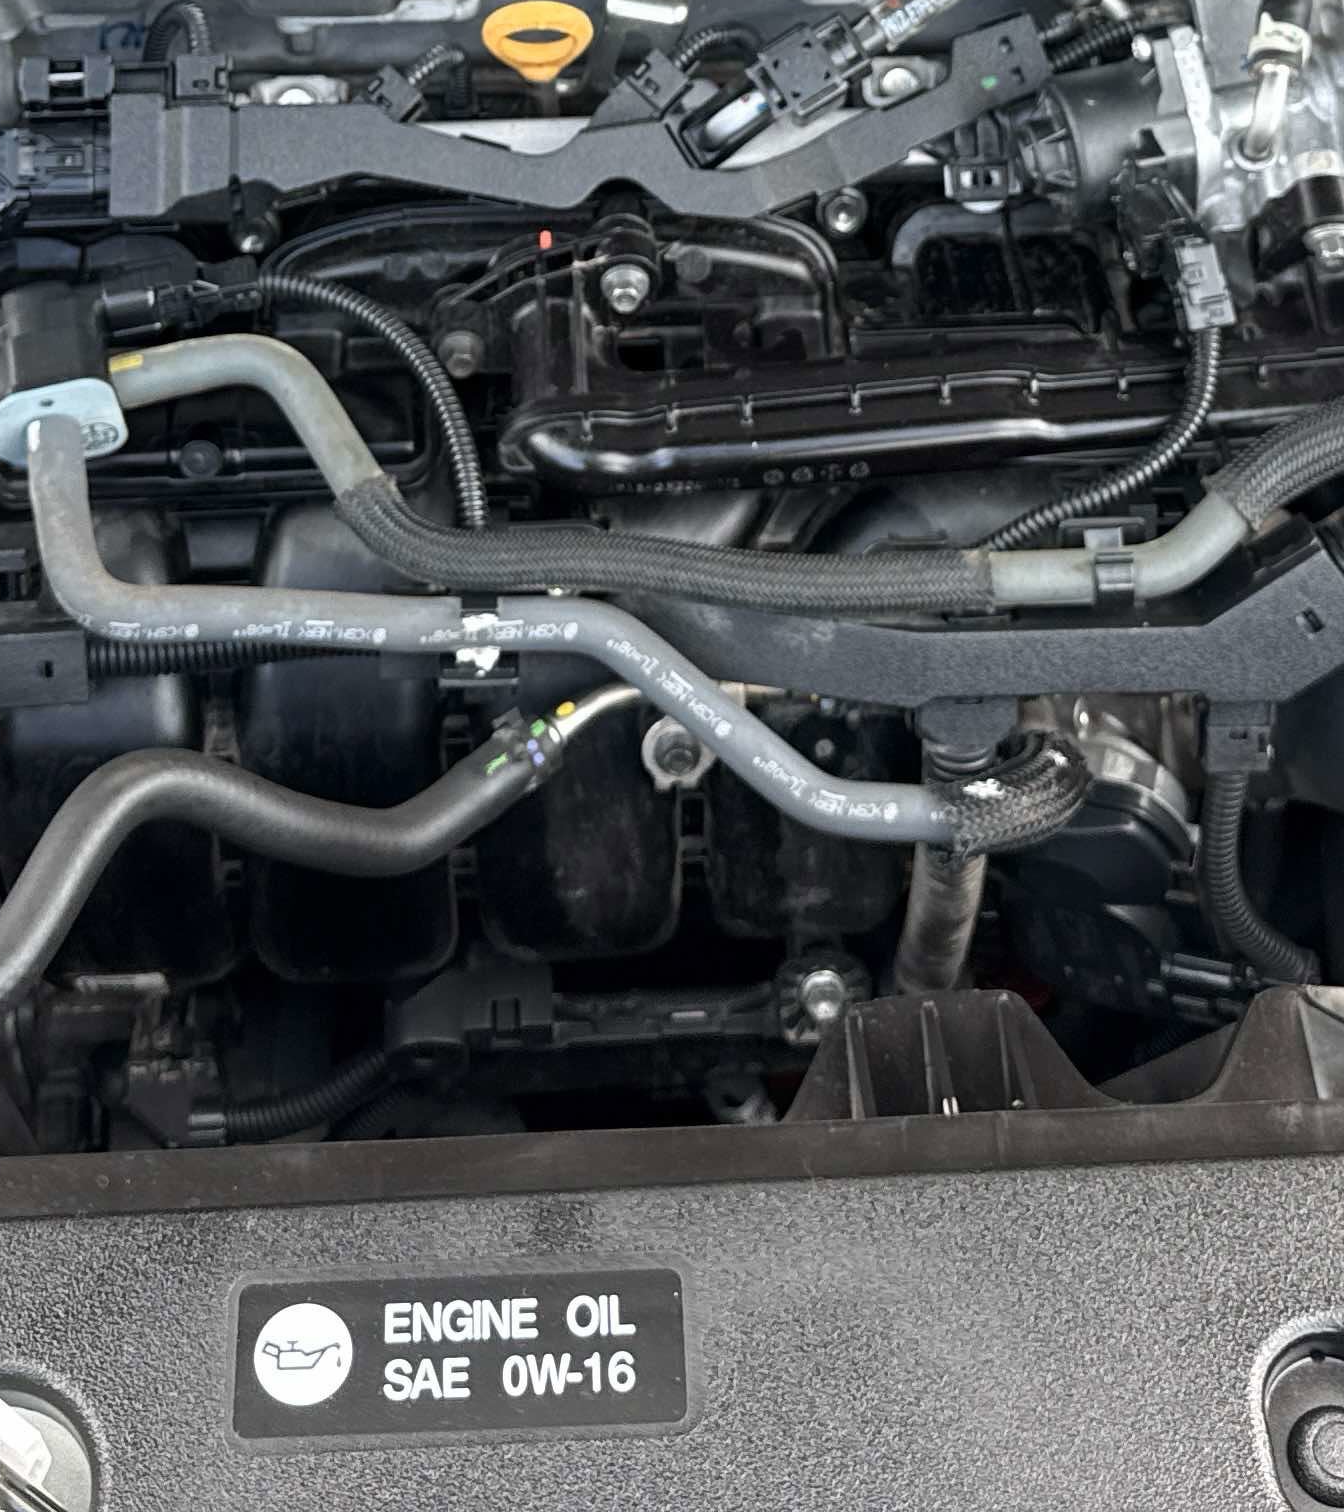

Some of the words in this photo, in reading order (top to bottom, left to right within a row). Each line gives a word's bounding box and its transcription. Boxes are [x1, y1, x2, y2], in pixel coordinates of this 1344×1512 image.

[384, 1298, 539, 1345] ENGINE
[566, 1294, 636, 1338] OIL
[383, 1357, 471, 1401] SAE
[502, 1351, 637, 1397] 0W-16
